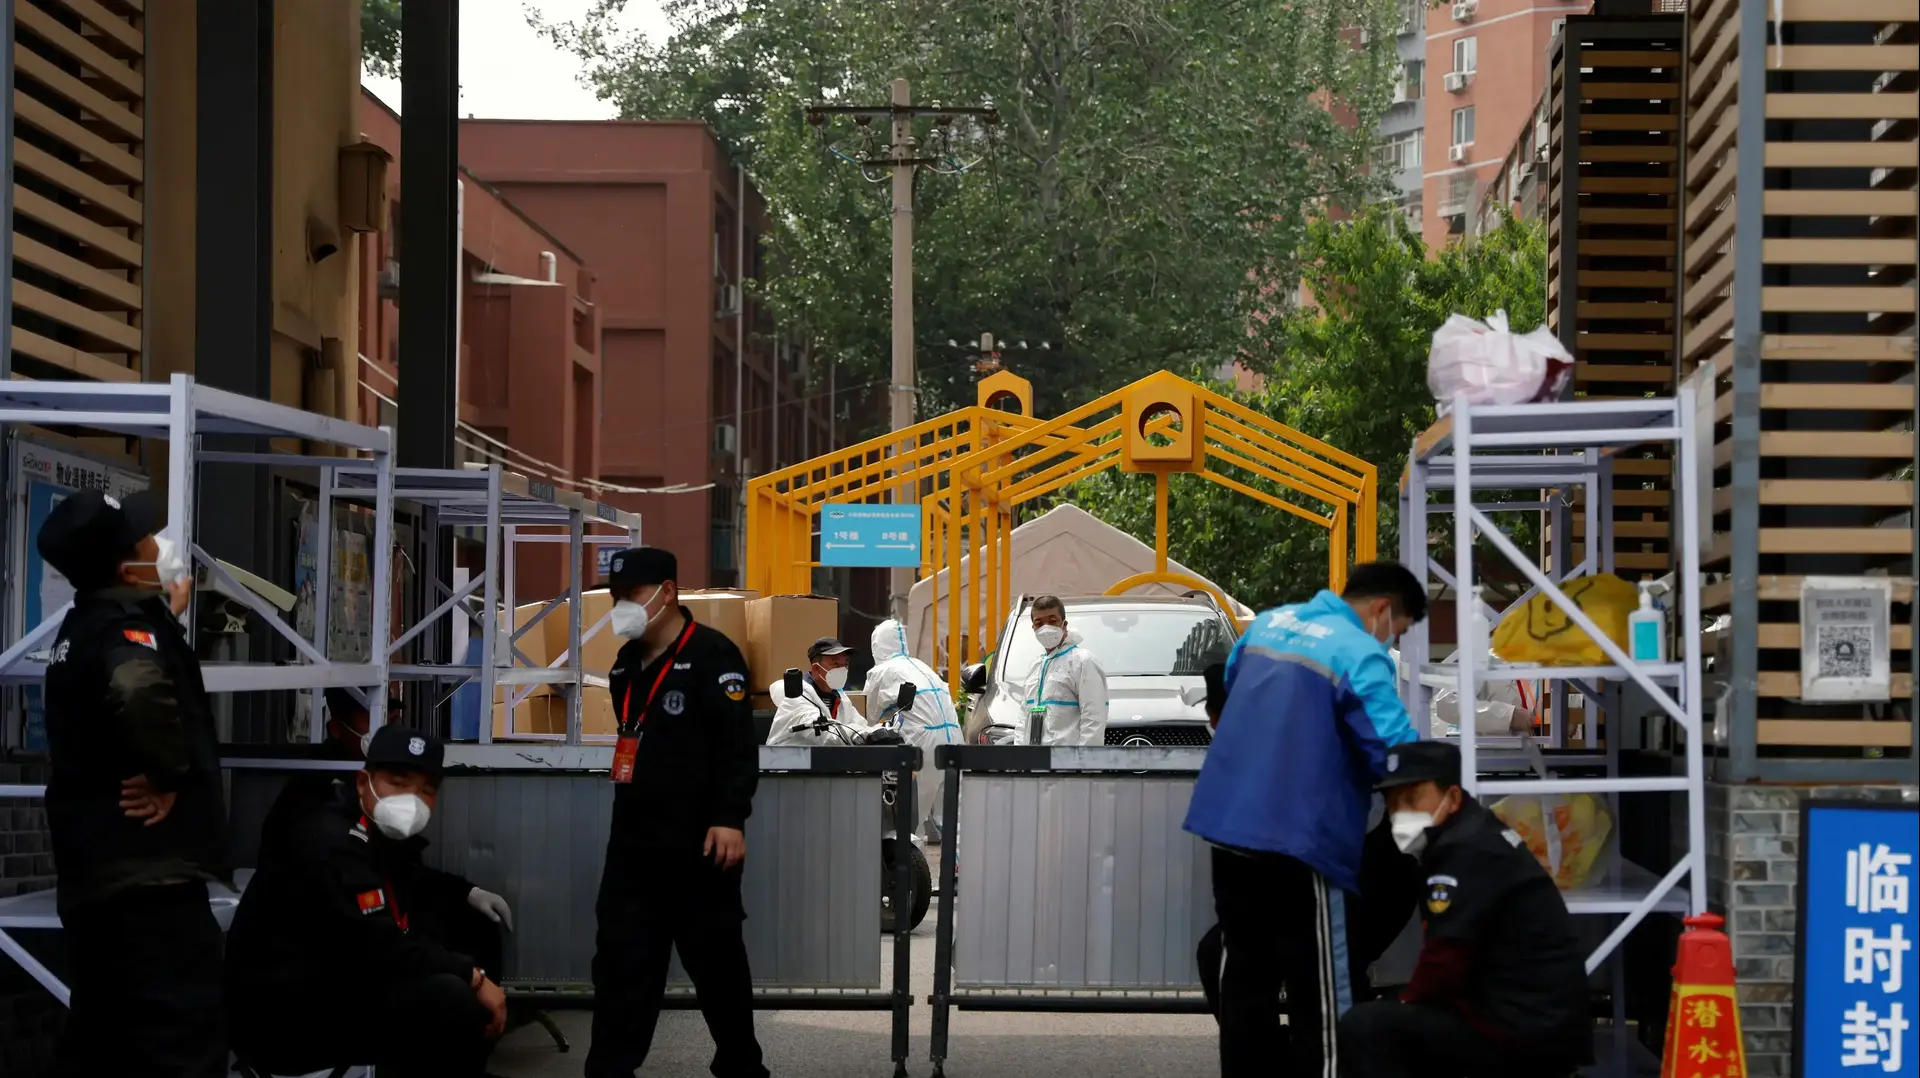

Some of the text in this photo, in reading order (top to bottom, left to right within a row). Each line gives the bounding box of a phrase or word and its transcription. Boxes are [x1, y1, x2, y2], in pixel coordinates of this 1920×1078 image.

[1841, 843, 1912, 1073] 临时封
[1684, 999, 1724, 1078] 潜水
